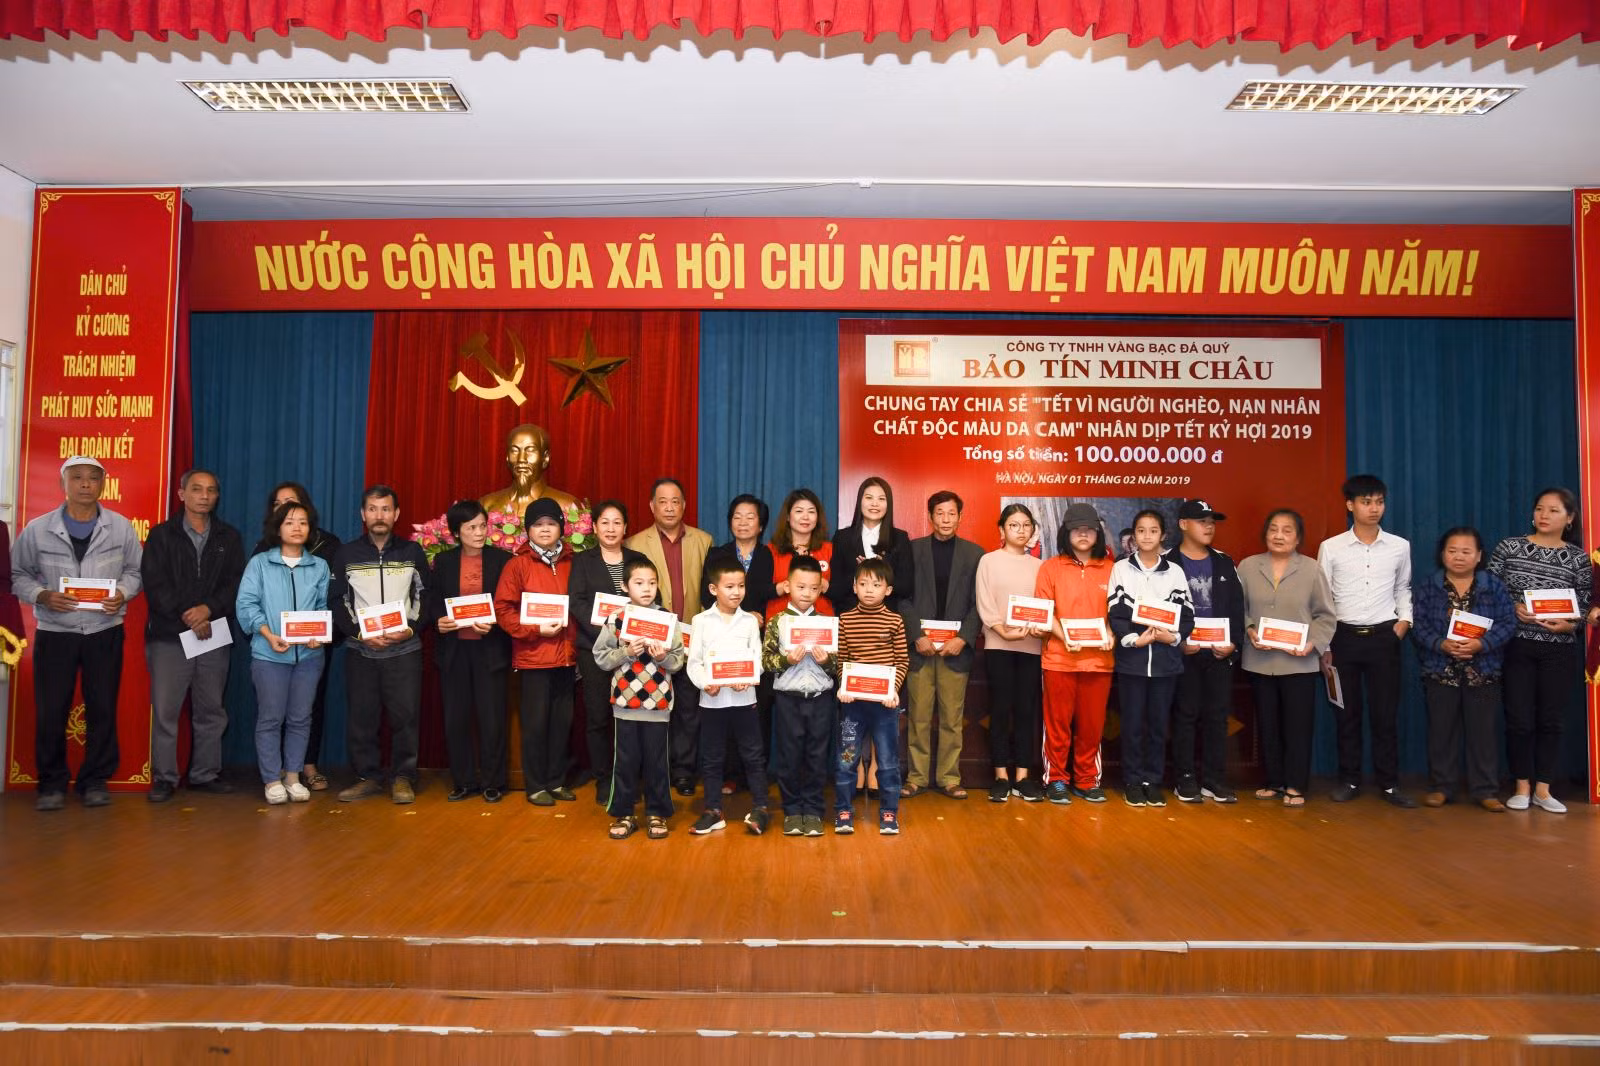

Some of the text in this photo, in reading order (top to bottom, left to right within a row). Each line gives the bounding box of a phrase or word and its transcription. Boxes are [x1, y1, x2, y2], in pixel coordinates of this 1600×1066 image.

[255, 223, 1480, 303] NƯỚC CỘNG HÒA XÃ HỘI CHỦ NGHĨA VIỆT NAM MUÔN NĂM!
[80, 264, 127, 296] DÂN CHỦ
[76, 304, 130, 336] KỶ CƯƠNG
[1006, 341, 1230, 356] CÔNG TY TNHH VÀNG BẠC ĐÁ QUÝ
[63, 350, 136, 382] TRÁCH NHIỆM
[961, 353, 1275, 381] BẢO TÍN MINH CHÂU
[41, 389, 153, 422] PHÁT HUY SỨC MẠNH
[863, 395, 926, 411] CHUNG
[929, 396, 960, 412] TAY
[963, 396, 1005, 413] CHIA
[1008, 392, 1028, 413] SẺ
[1075, 394, 1094, 413] VÌ
[1097, 395, 1155, 414] NGƯỜI
[1159, 397, 1225, 416] NGHÈO,
[1229, 399, 1266, 418] NẠN
[1270, 396, 1321, 415] NHÂN
[81, 432, 111, 459] ĐOÀN
[113, 428, 135, 459] KẾT
[873, 416, 1313, 443] CHẤT ĐỘC MÀU DA CAM" NHÂN DỊP TẾT KỶ HỢI 2019
[963, 444, 1224, 464] Tổng số tiền: 100.000.000 đ
[98, 473, 122, 503] ÂN,
[995, 471, 1012, 484] HÀ
[1037, 472, 1068, 485] NGÀY
[1069, 475, 1081, 485] 01
[1084, 474, 1122, 485] THÁNG
[1123, 475, 1136, 485] 02
[1138, 473, 1163, 485] NĂM
[1165, 475, 1191, 485] 2019
